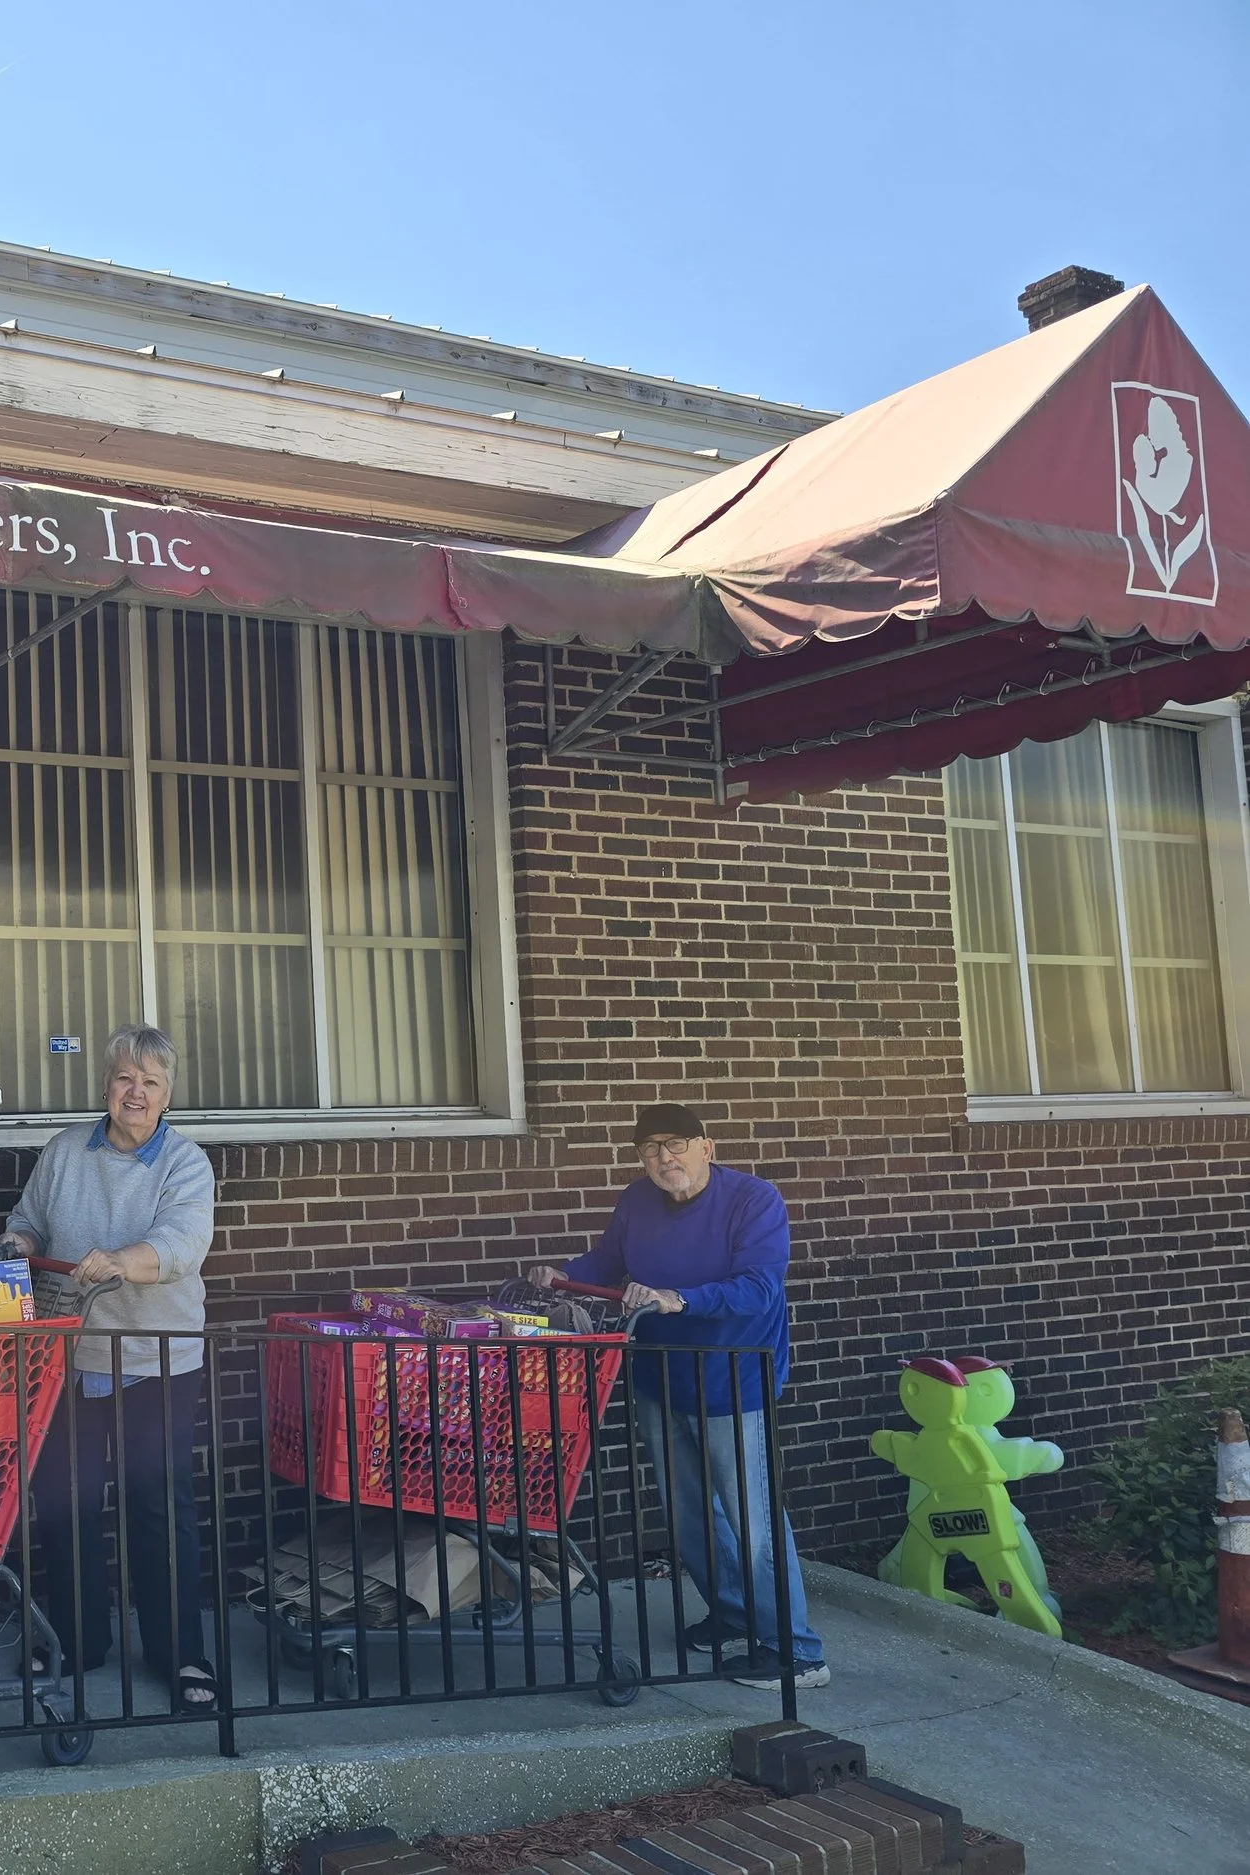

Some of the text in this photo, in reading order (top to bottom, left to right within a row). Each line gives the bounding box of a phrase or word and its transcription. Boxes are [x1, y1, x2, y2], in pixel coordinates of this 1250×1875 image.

[96, 506, 212, 576] Inc.
[519, 1316, 538, 1325] SIZE
[932, 1513, 986, 1533] SLOW!
